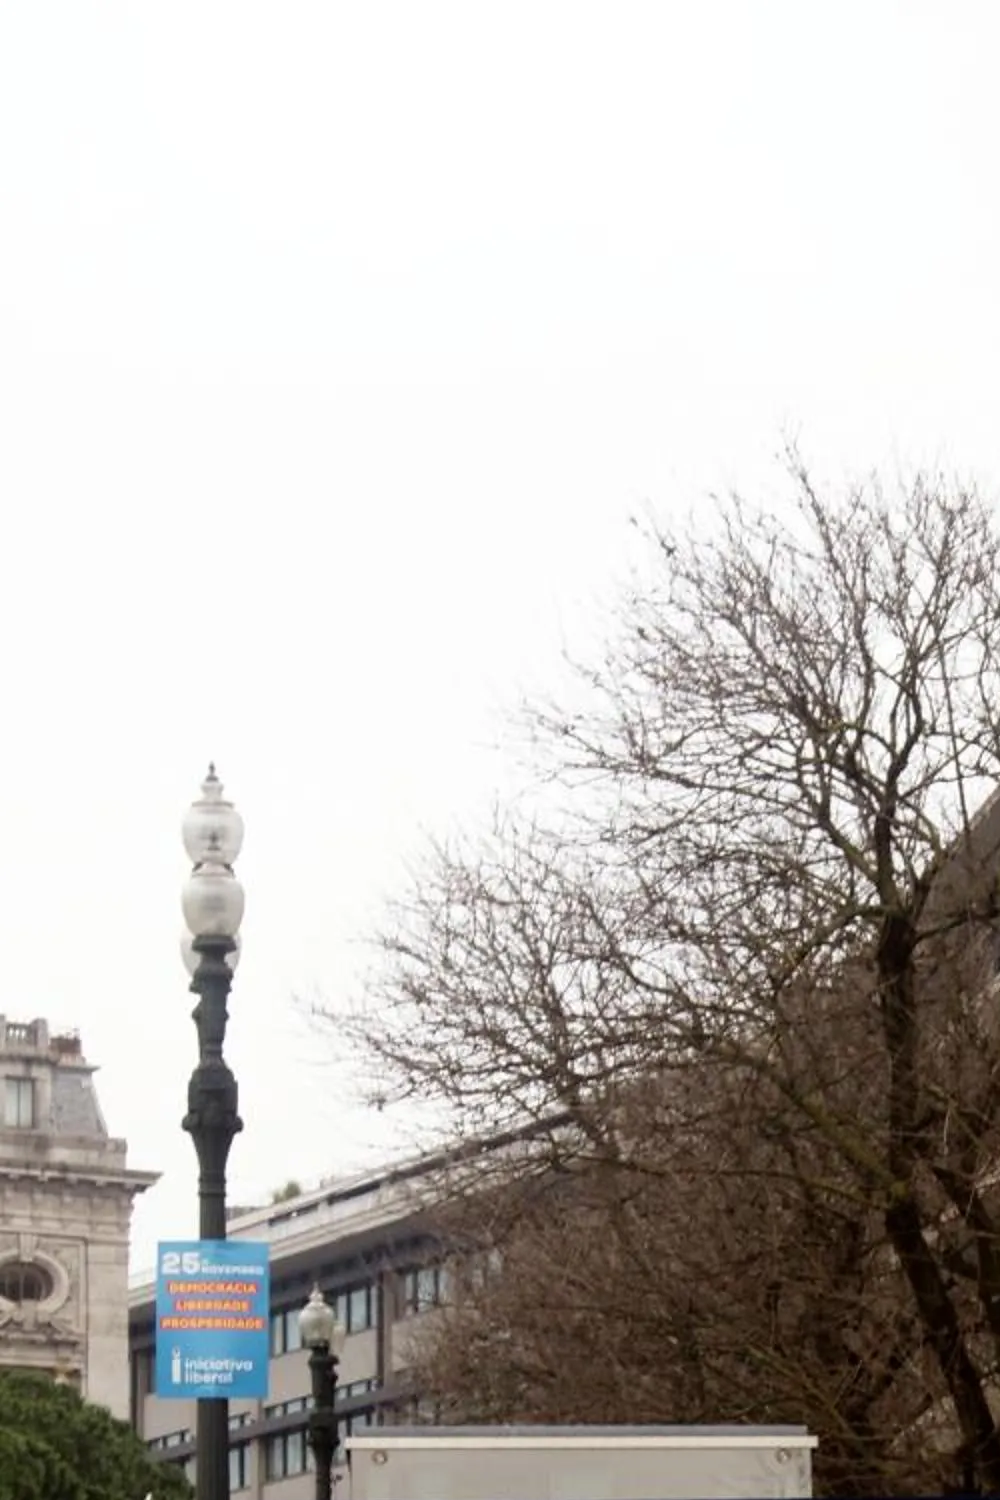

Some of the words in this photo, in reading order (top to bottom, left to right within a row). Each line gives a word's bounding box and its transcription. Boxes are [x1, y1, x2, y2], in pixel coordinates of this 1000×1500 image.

[162, 1252, 199, 1275] 25
[168, 1281, 257, 1294] DEMOCRACIA
[185, 1357, 254, 1372] iniciativa
[185, 1371, 233, 1385] liberal
